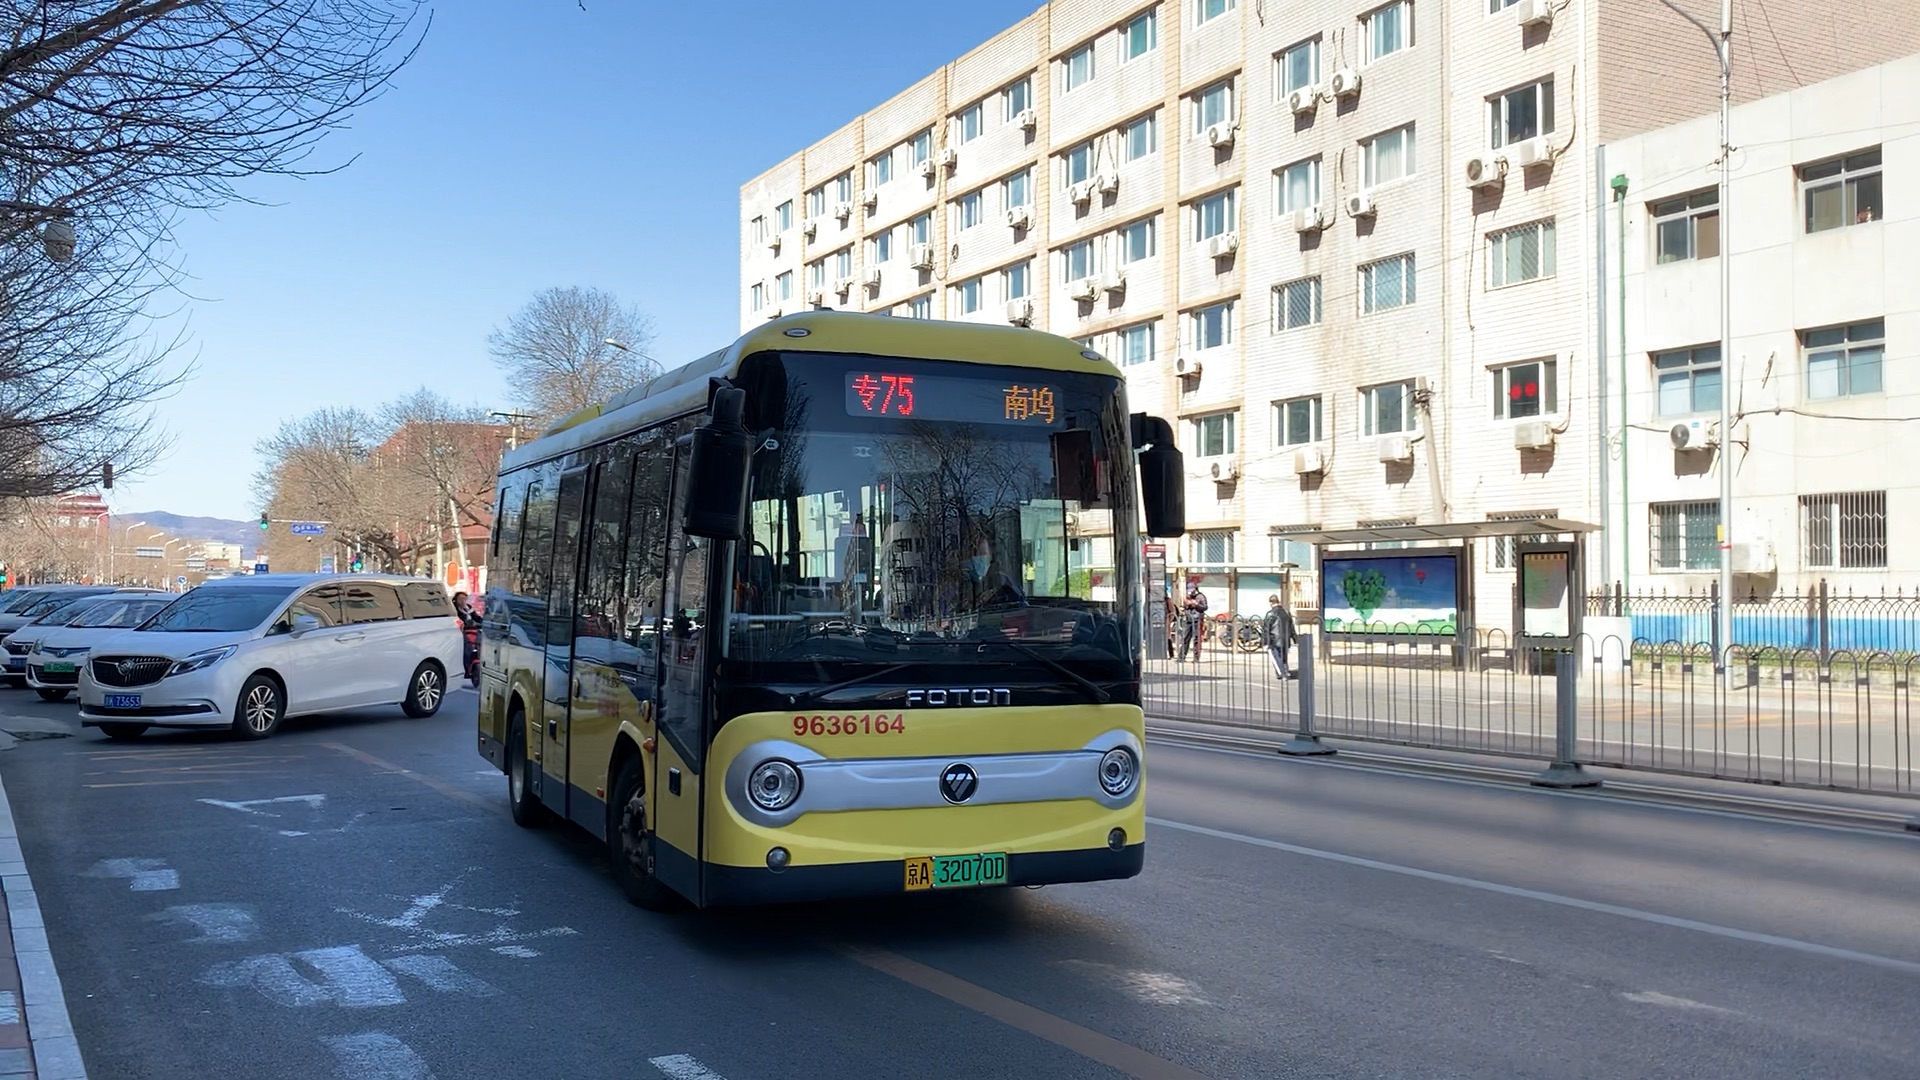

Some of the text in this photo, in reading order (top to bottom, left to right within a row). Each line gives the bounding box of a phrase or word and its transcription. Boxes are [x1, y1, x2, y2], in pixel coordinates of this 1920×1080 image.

[852, 375, 915, 416] 专75
[1002, 384, 1055, 424] 南坞
[906, 688, 1011, 707] FOTON
[792, 714, 905, 737] 9636164
[938, 857, 1005, 883] 32070D
